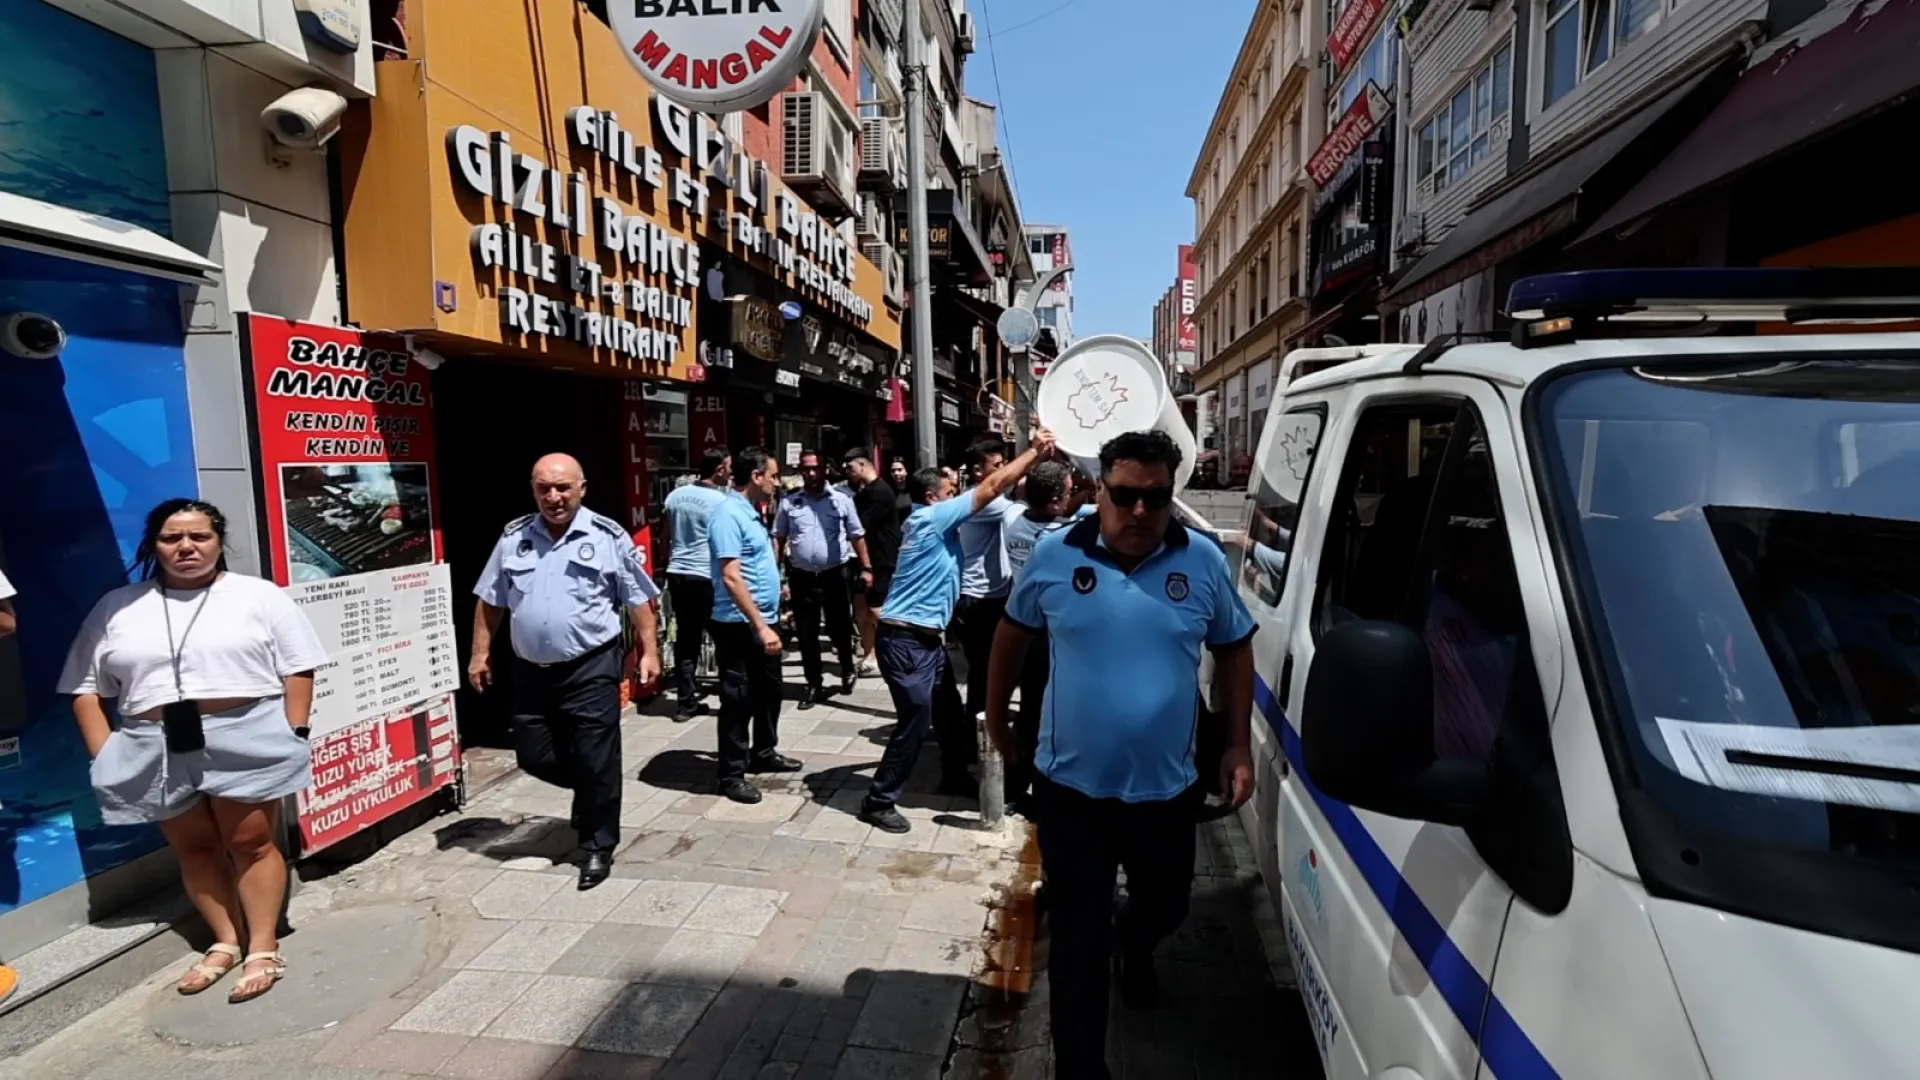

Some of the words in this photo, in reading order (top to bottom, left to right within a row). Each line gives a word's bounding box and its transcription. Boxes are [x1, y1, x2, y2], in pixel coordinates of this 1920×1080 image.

[633, 25, 793, 89] MANGAL
[449, 124, 587, 237] GİZLİ
[602, 197, 700, 287] BAHÇE
[569, 105, 663, 188] AİLE
[671, 167, 709, 217] ET
[735, 212, 796, 272] BALIK
[798, 255, 874, 323] RESTAURANT
[775, 187, 856, 283] BAHÇE
[474, 221, 558, 283] AİLE
[570, 254, 602, 298] ET
[628, 279, 691, 329] BALIK
[502, 286, 679, 364] RESTAURANT
[288, 337, 409, 378] BAHÇE
[715, 347, 733, 370] LG
[268, 368, 425, 406] MANGAL
[285, 410, 367, 432] KENDİN
[373, 413, 421, 437] PİŞİR
[306, 436, 384, 457] KENDİN
[389, 440, 410, 457] YE
[293, 590, 343, 604] EYLERBEYİ
[345, 585, 366, 596] MAVİ
[304, 582, 326, 593] YENİ
[328, 580, 349, 589] RAKI
[350, 732, 372, 757] ŞİŞ
[311, 805, 350, 836] KUZU
[352, 775, 414, 816] UYKULUK
